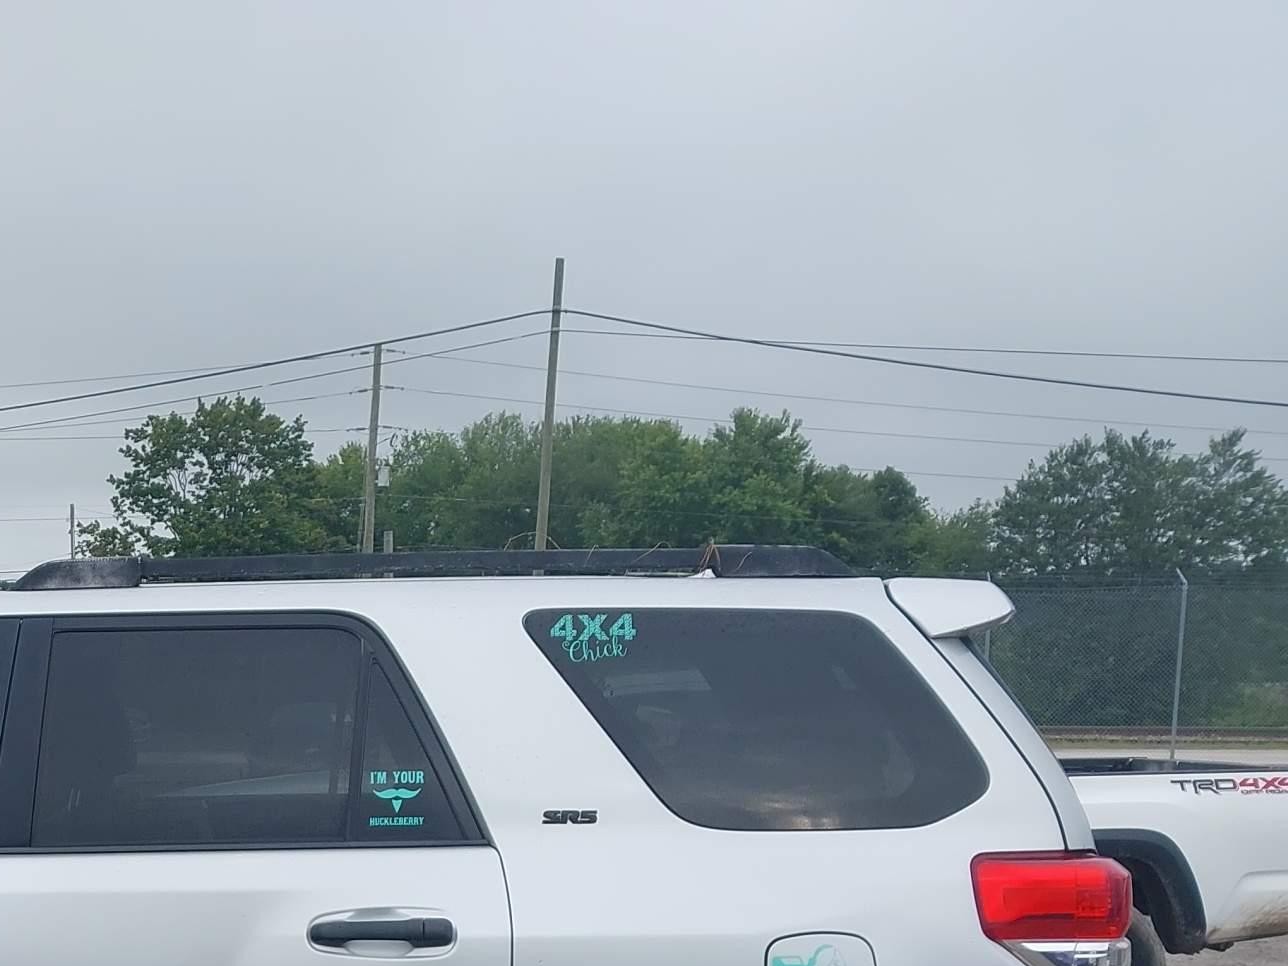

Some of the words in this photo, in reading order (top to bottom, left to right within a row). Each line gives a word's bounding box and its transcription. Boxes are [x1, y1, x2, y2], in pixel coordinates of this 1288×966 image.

[550, 613, 637, 640] 4X4
[561, 635, 628, 663] Chick
[370, 771, 387, 785] I'M
[393, 770, 424, 784] YOUR
[1170, 779, 1239, 794] TRD
[369, 816, 425, 827] HUCKLEBERRY
[542, 810, 598, 824] SR5
